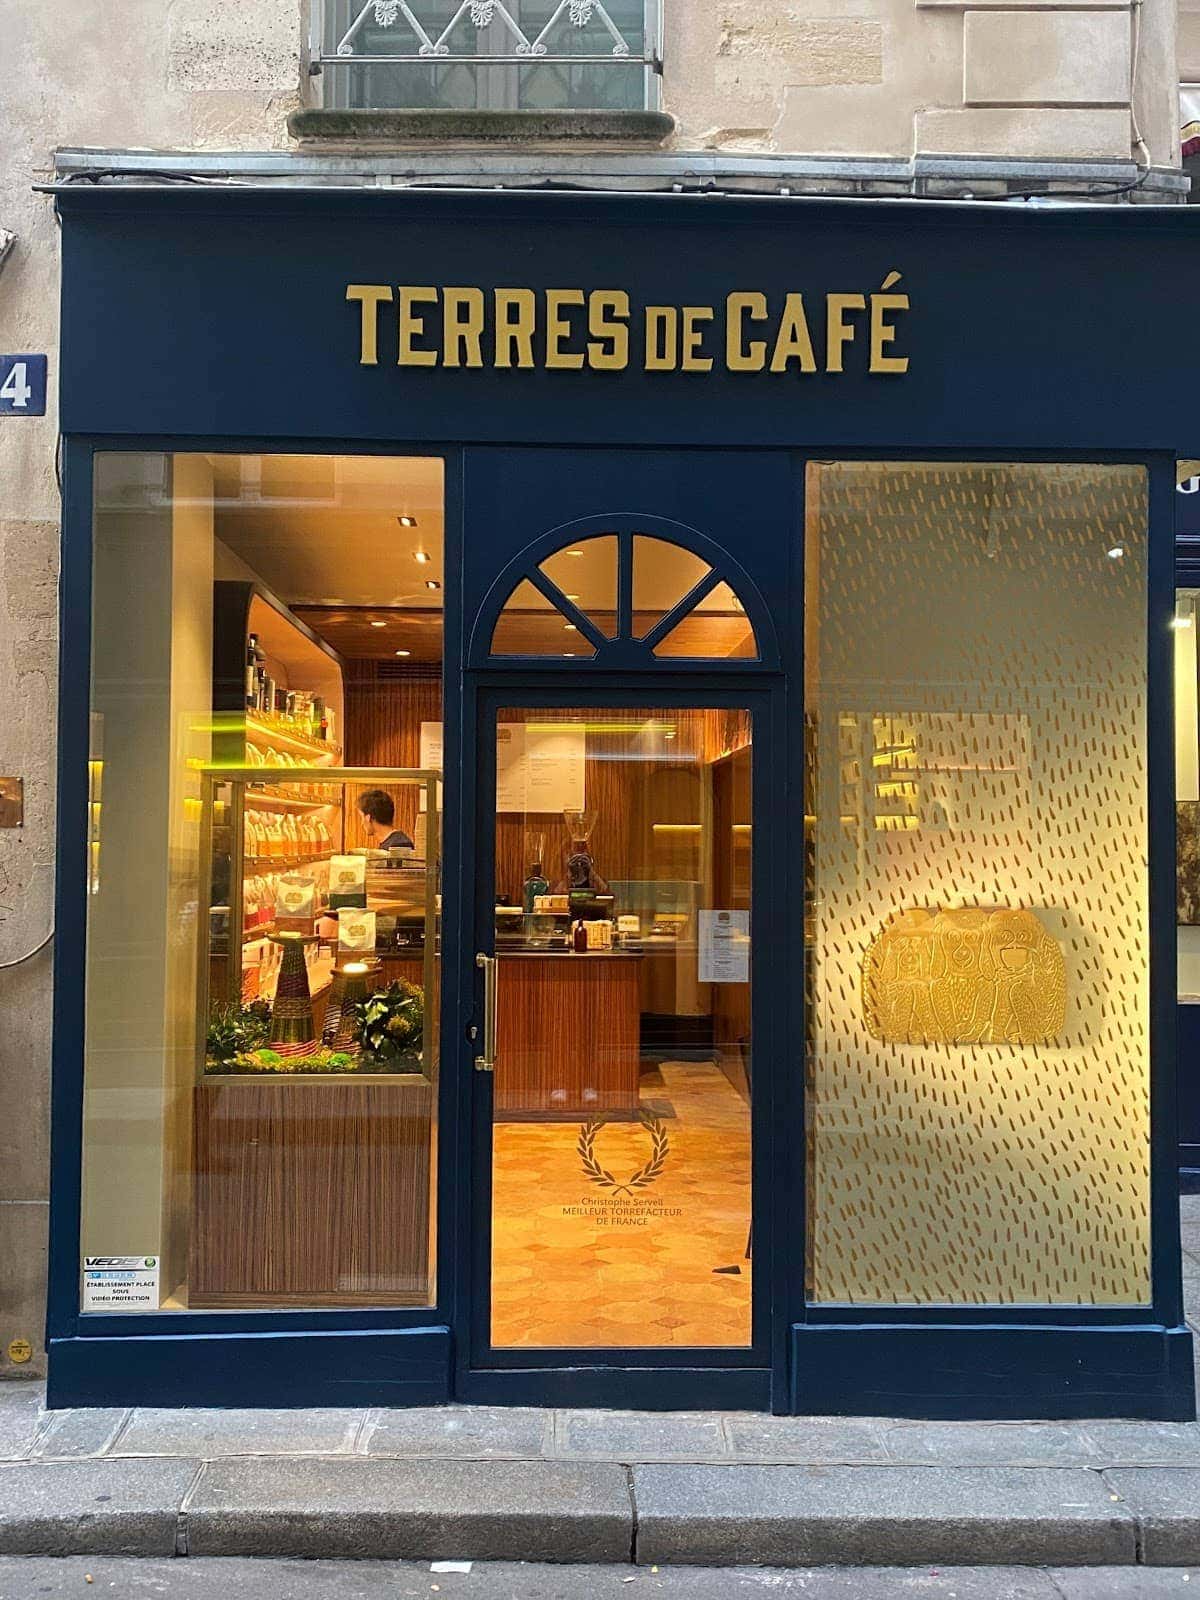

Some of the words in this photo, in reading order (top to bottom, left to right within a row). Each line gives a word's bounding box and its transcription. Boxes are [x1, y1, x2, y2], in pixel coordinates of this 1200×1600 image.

[345, 283, 630, 372] TERRES
[644, 305, 714, 372] DE
[726, 270, 911, 373] CAFÉ
[0, 362, 31, 407] 4
[581, 1197, 631, 1208] Christophe
[562, 1207, 607, 1216] MEILLEUR
[596, 1217, 609, 1226] DE
[611, 1217, 648, 1226] FRANCE
